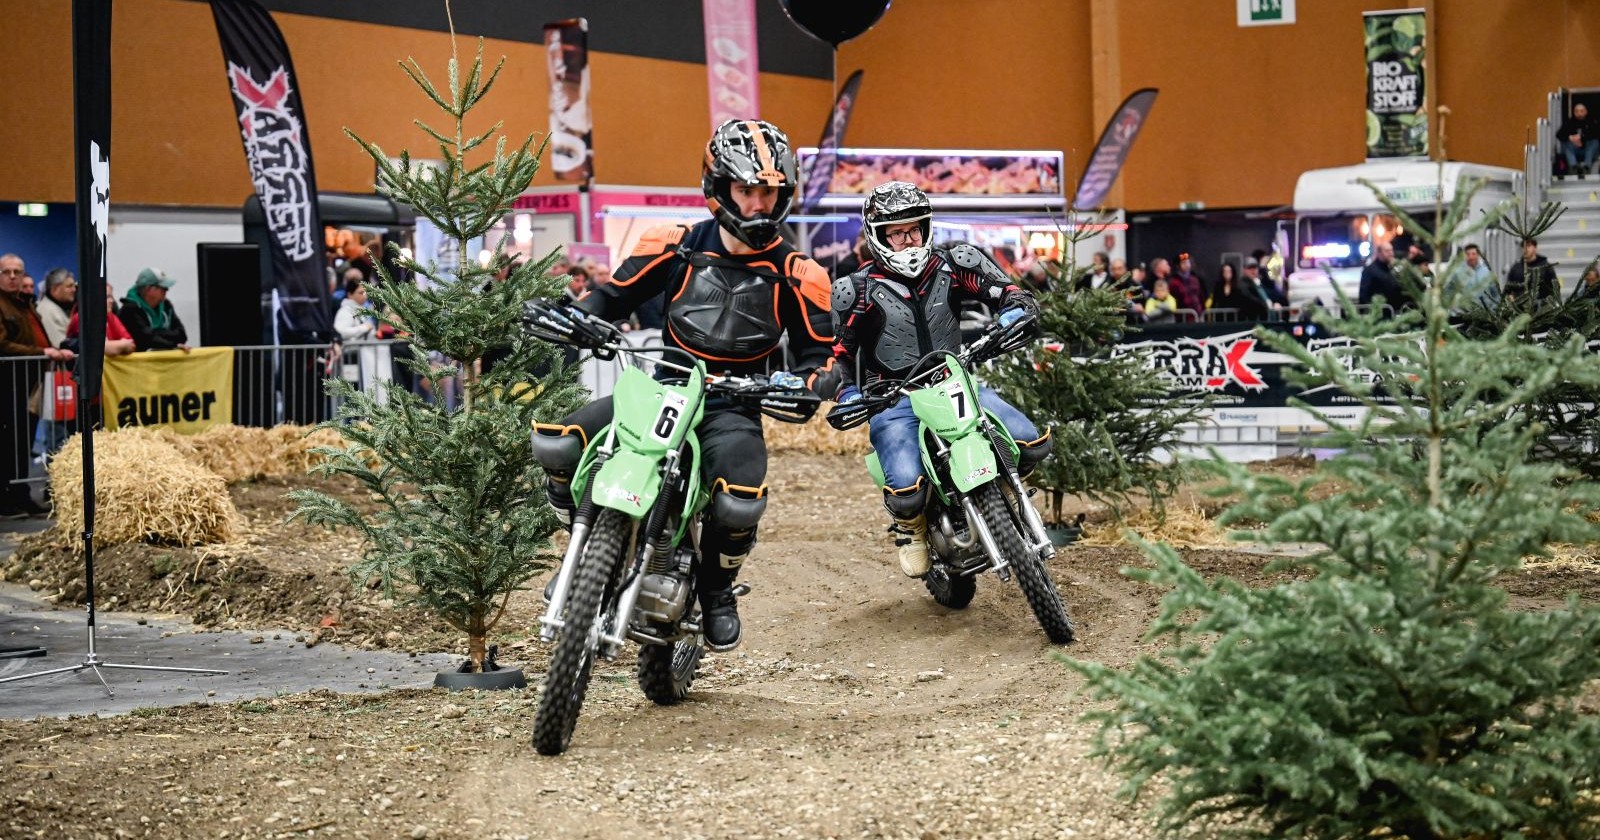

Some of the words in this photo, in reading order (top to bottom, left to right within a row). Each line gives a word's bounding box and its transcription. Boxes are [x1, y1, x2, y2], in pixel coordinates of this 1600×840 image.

[1372, 61, 1402, 77] BIO
[1373, 75, 1417, 92] KRAFT
[1373, 90, 1417, 107] STOFF
[117, 390, 217, 428] auner
[950, 391, 966, 419] 7
[654, 406, 679, 439] 6
